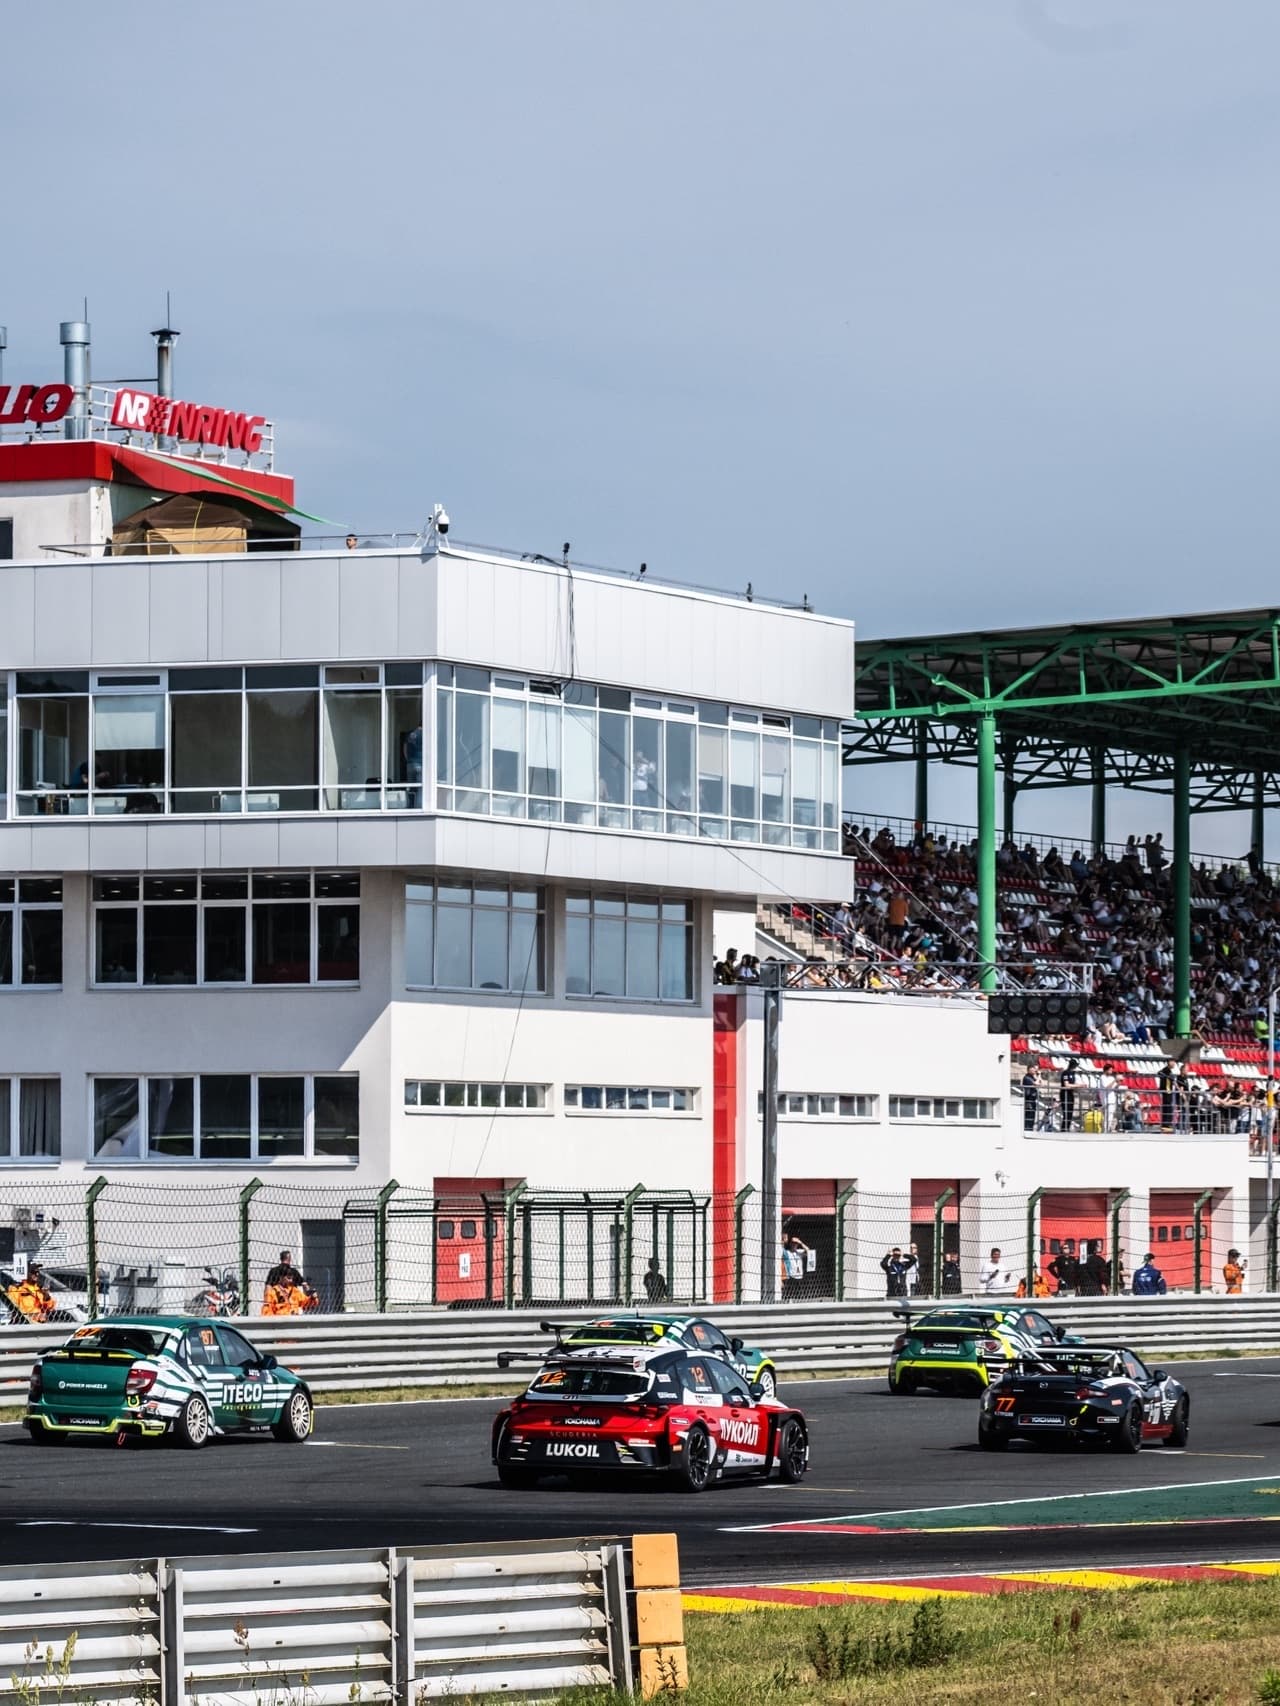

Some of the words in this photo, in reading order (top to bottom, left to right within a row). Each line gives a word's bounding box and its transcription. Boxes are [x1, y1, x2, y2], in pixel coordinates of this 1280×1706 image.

[167, 401, 265, 452] NRING
[691, 1366, 706, 1383] 12
[223, 1383, 262, 1403] ITECO
[996, 1397, 1016, 1412] 77
[719, 1417, 760, 1447] ЛУКОЙЛ
[546, 1443, 600, 1458] LUKOIL
